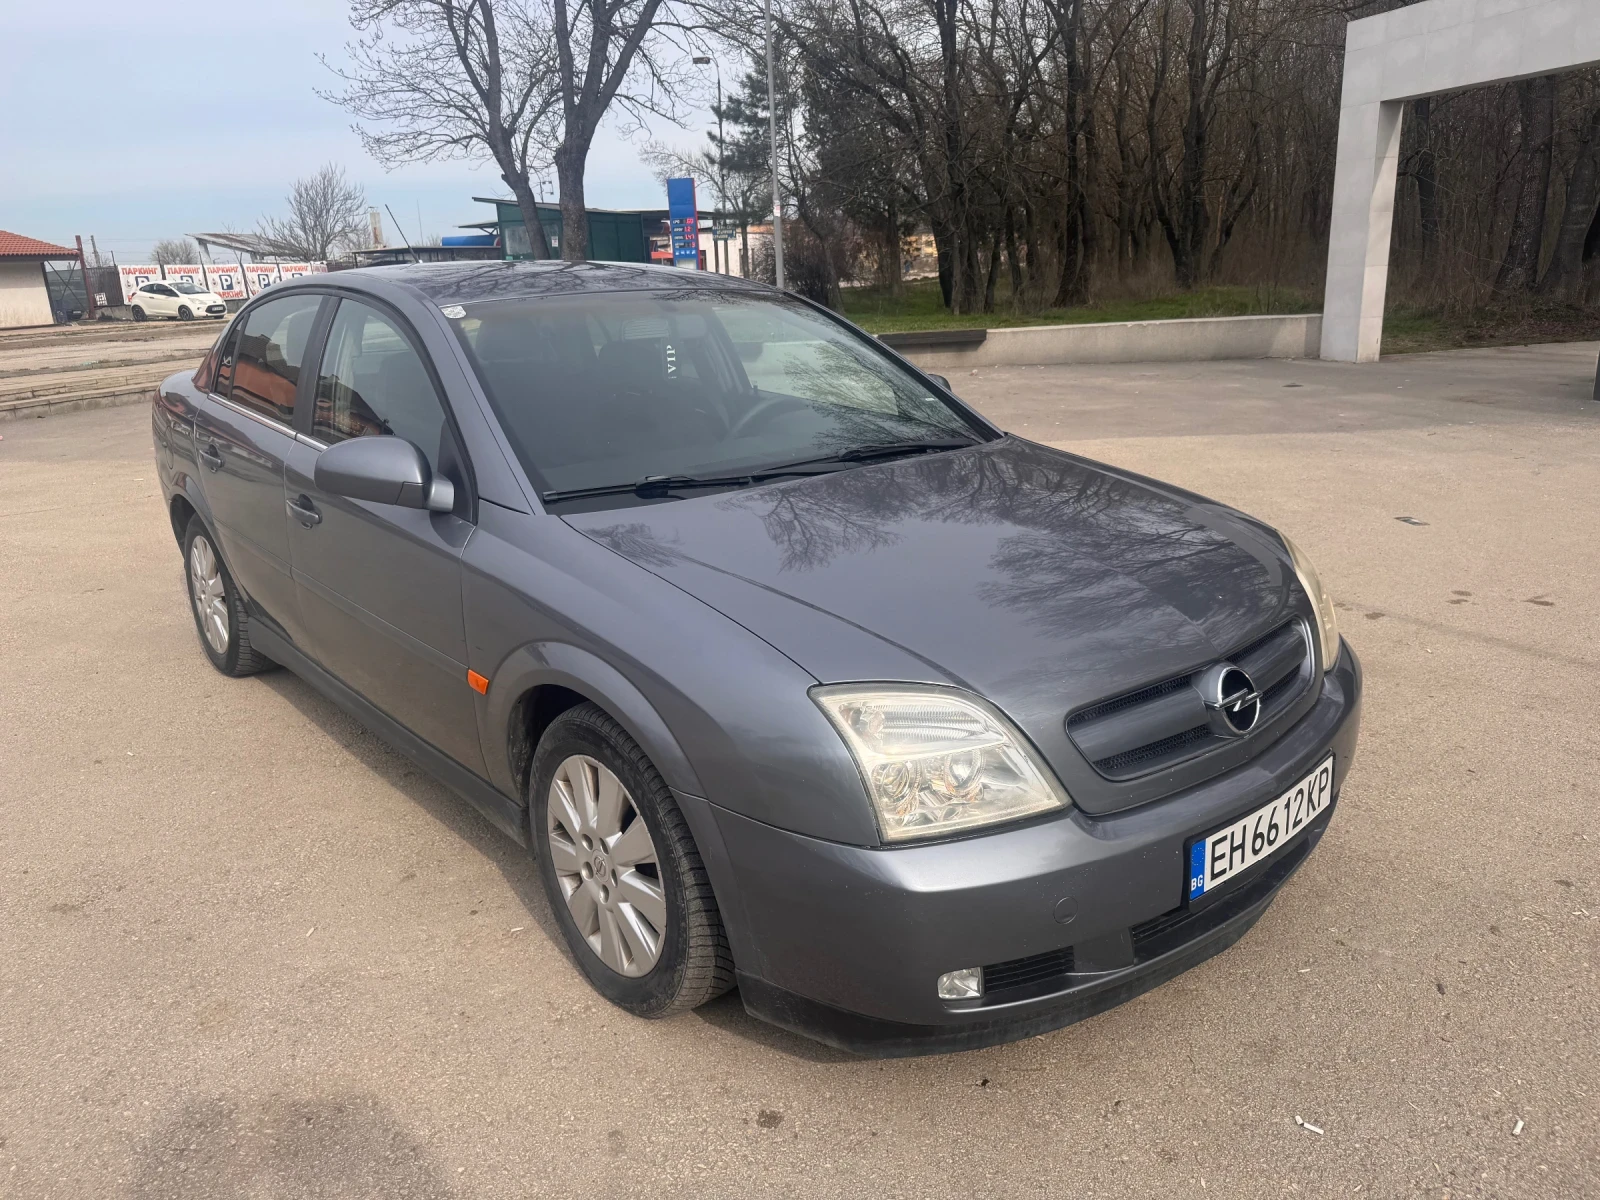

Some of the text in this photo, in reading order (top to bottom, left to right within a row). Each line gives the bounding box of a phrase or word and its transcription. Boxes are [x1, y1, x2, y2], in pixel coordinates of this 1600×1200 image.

[121, 267, 158, 275] ПАРКИНГ
[167, 266, 201, 275] ПАРКИНГ
[207, 266, 239, 274] ПАРКИНГ
[246, 265, 276, 273] ПАРКИНГ
[214, 290, 244, 299] ARKING
[666, 344, 676, 374] VIP
[1210, 766, 1329, 882] EH6612KP
[1191, 874, 1204, 891] BG
